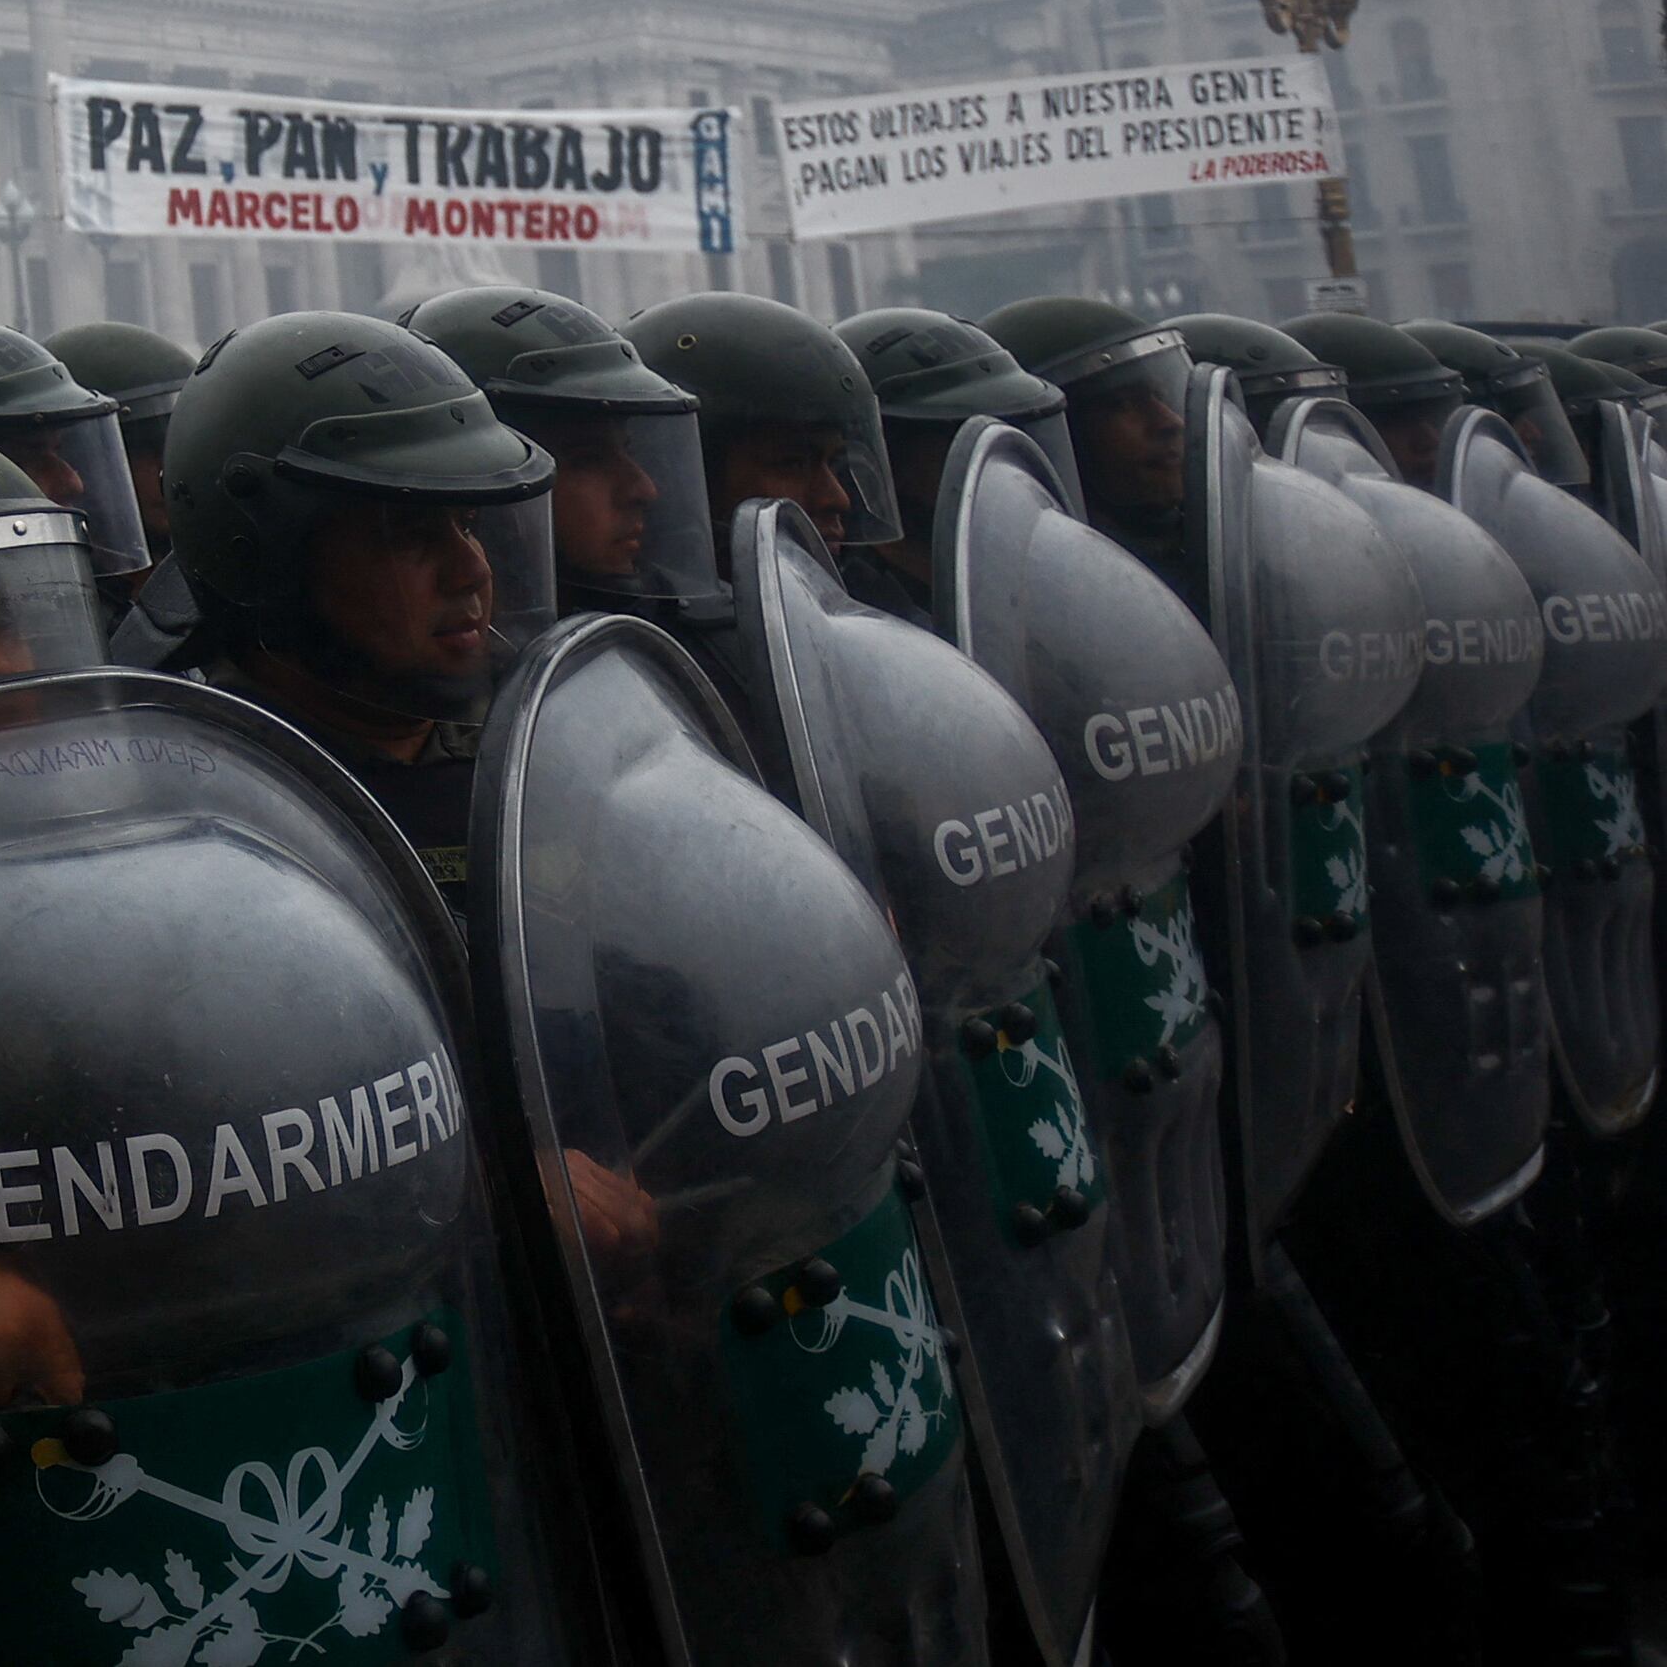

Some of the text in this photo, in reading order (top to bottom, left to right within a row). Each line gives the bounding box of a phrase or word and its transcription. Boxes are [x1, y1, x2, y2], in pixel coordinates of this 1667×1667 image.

[782, 110, 859, 151] ESTOS
[869, 94, 987, 140] ULTRAJES
[1006, 91, 1024, 123] A
[1042, 77, 1173, 119] NUESTRA
[237, 109, 357, 181] PAN
[383, 118, 662, 193] TRABAJO
[901, 145, 947, 184] LOS
[957, 132, 1052, 174] VIAJES
[1067, 125, 1110, 160] DEL
[1189, 150, 1330, 182] LA PODEROSA
[167, 188, 359, 232] MARCELO
[404, 197, 599, 241] MONTERO
